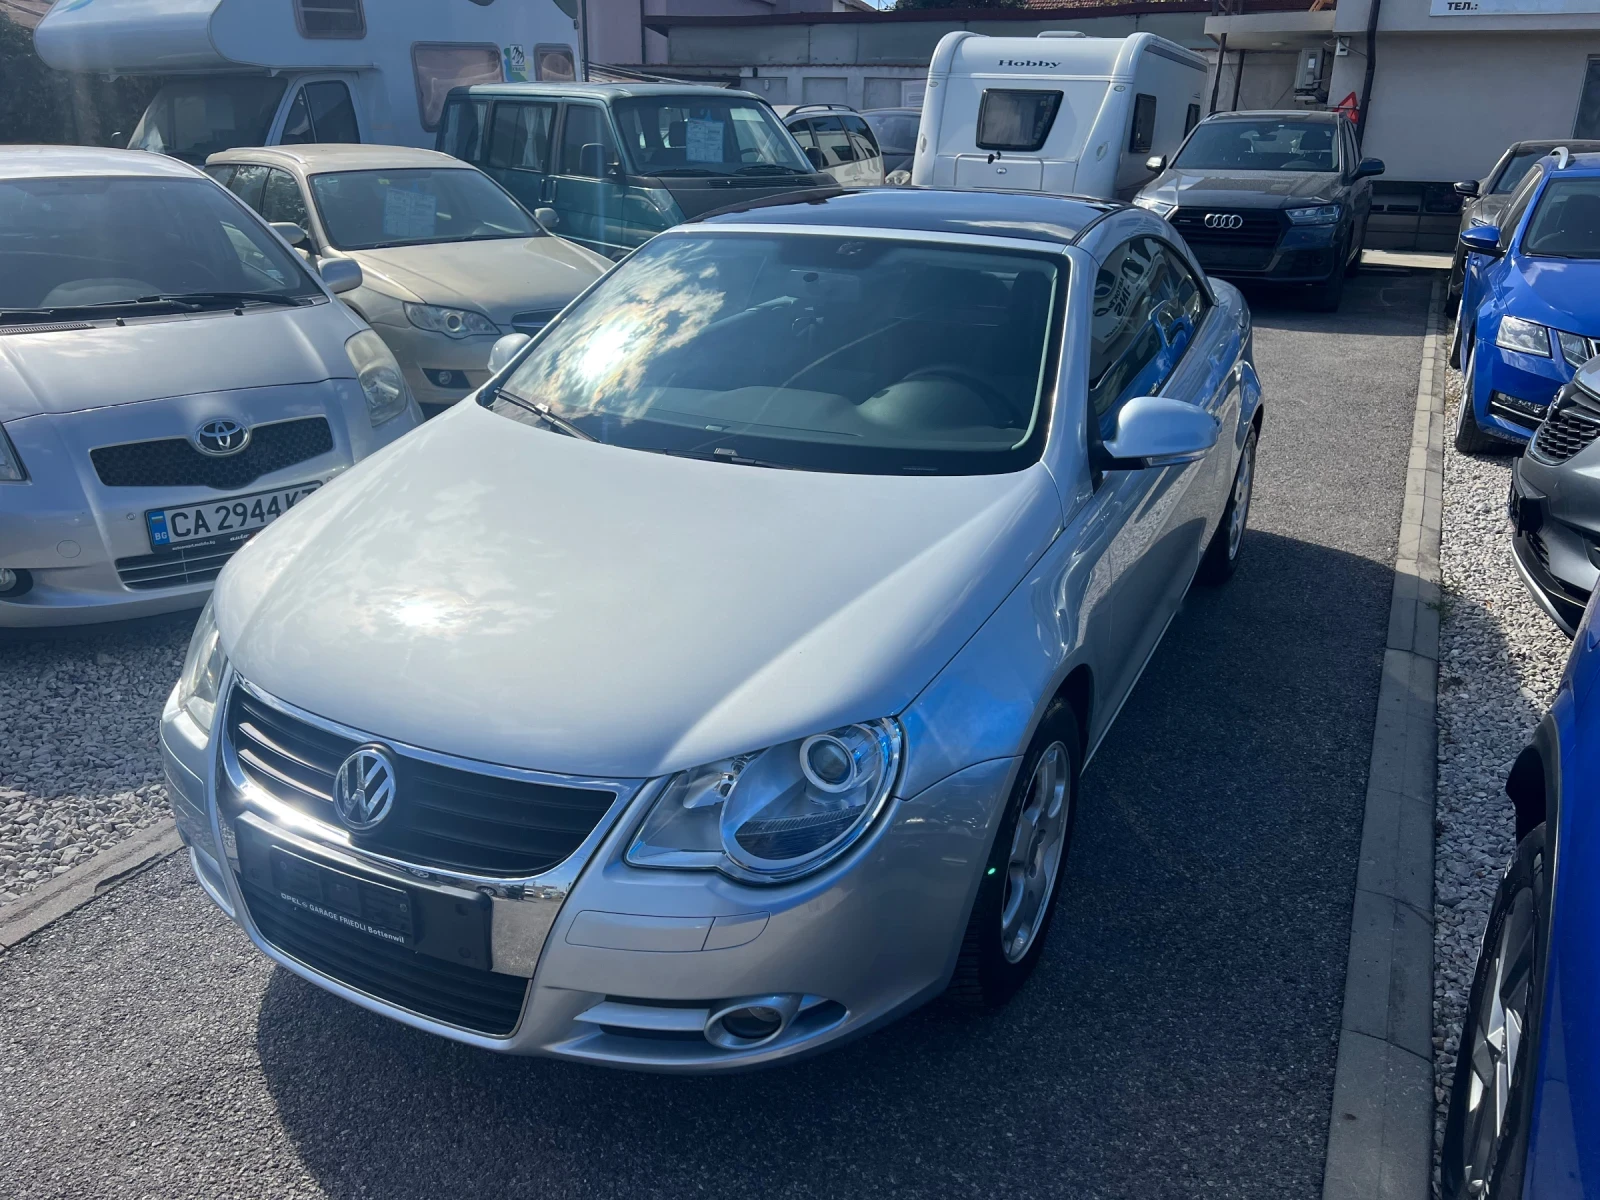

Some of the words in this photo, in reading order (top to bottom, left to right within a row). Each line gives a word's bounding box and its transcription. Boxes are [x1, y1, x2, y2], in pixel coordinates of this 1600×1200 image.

[1447, 2, 1478, 10] ТЕЛ.:
[999, 60, 1062, 68] Hobby
[215, 495, 282, 530] 2944
[155, 531, 167, 541] BG
[281, 892, 302, 906] OPEL
[309, 903, 338, 921] GARAGE
[339, 915, 367, 932] FRIEDLI
[367, 925, 405, 944] Bottenwil
